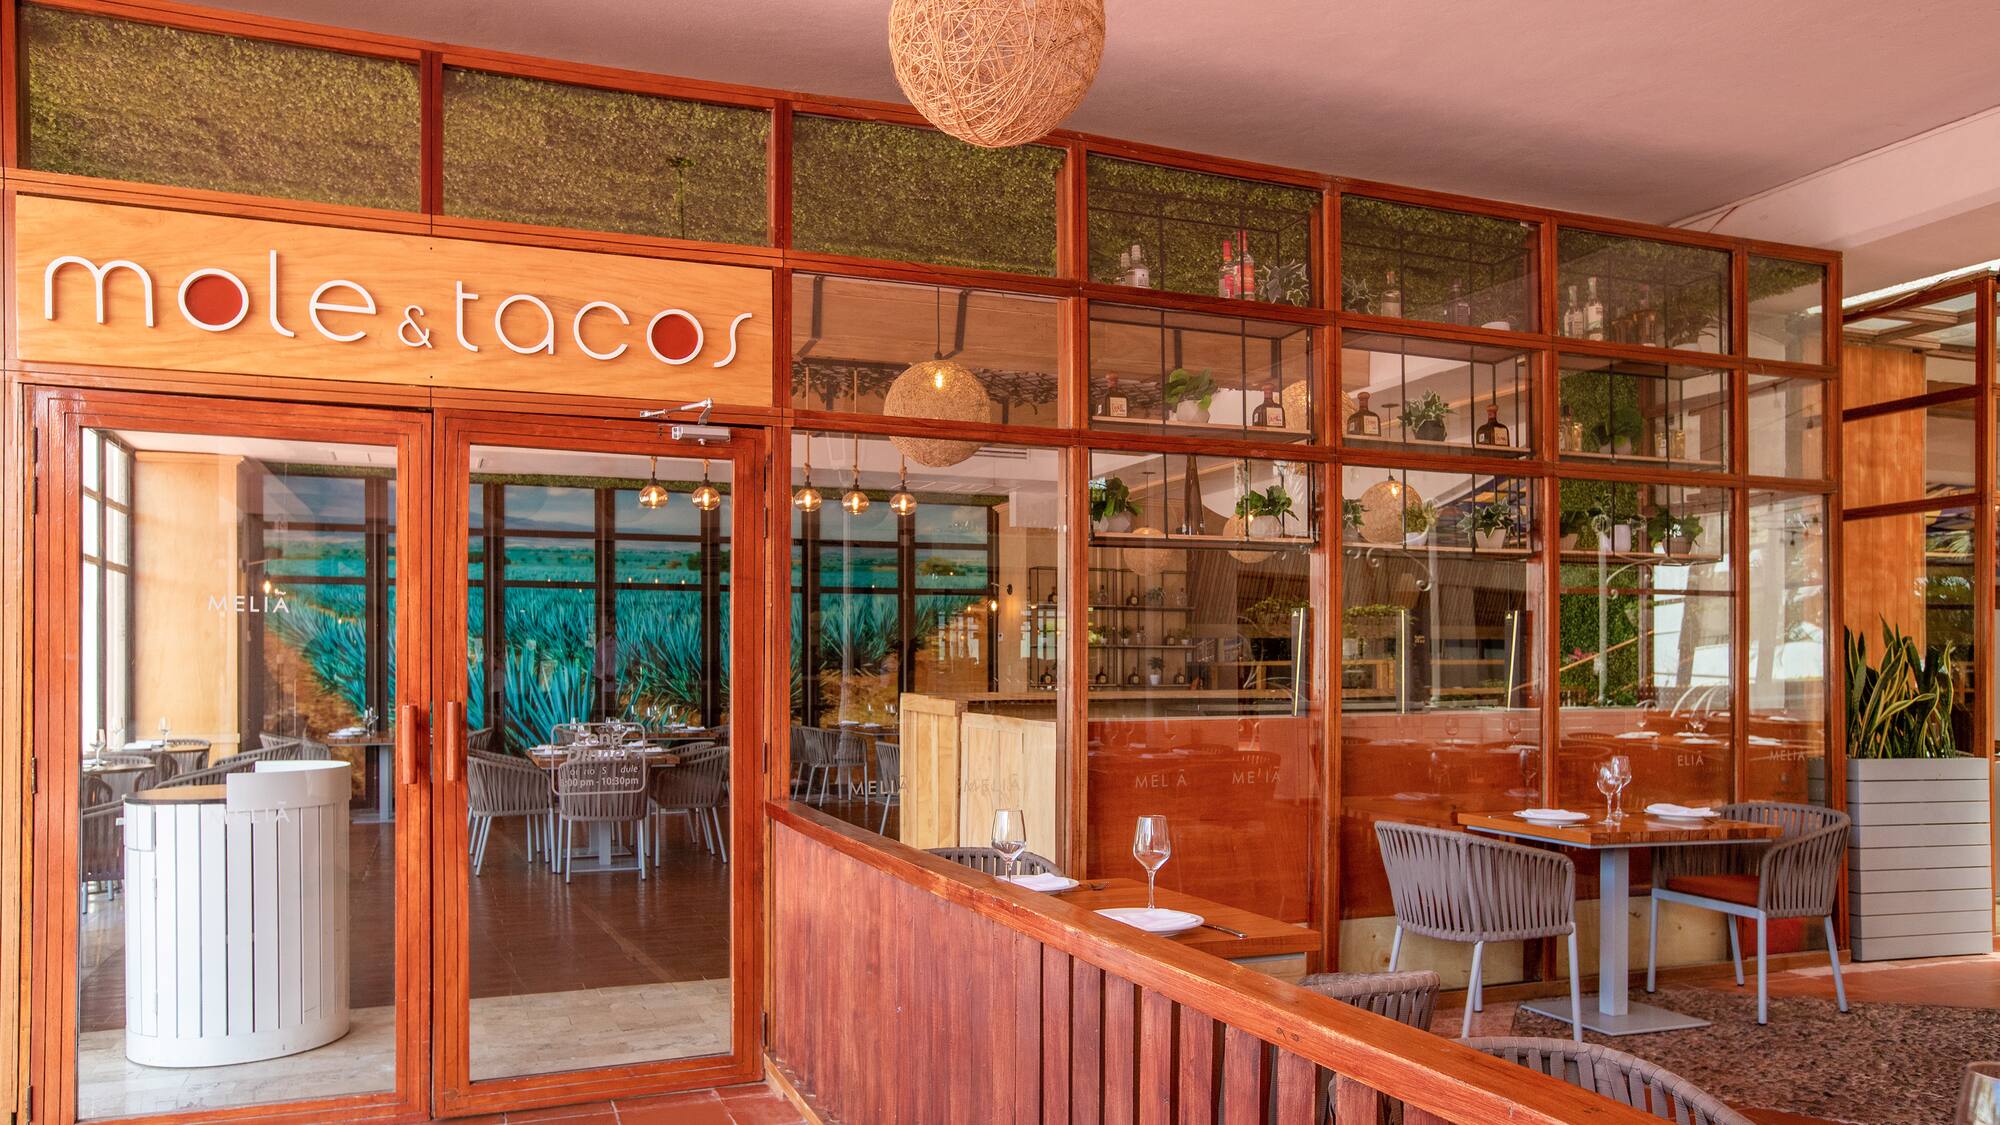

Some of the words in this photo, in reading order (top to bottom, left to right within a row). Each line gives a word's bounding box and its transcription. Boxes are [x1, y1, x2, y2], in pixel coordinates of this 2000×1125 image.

[45, 249, 377, 343] mole
[398, 304, 433, 349] &
[455, 280, 754, 369] tacos
